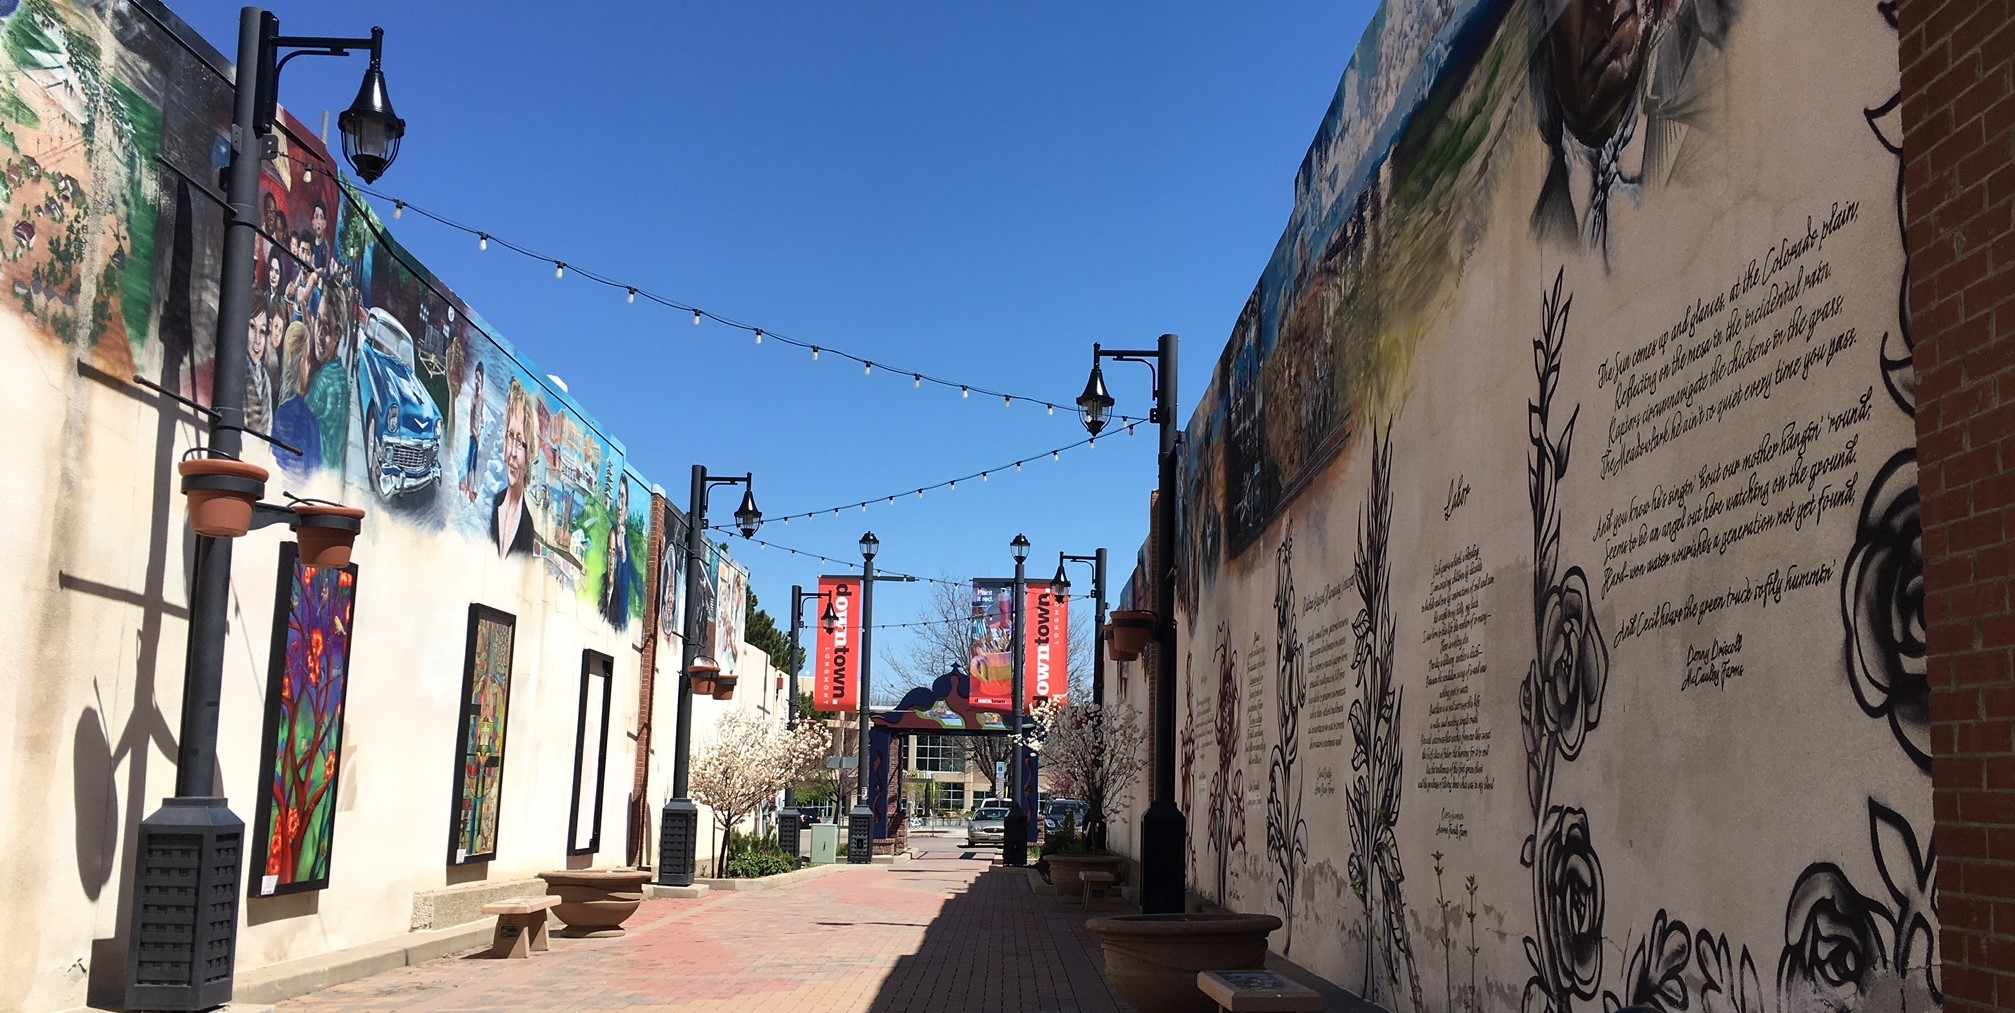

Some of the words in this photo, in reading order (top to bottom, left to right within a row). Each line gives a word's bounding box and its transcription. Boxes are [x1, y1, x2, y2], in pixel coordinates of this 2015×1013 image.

[1615, 371, 1657, 411] Reflecting
[1659, 363, 1670, 382] on
[1671, 344, 1688, 376] the
[1686, 337, 1712, 366] mesa
[1712, 328, 1722, 348] in
[1725, 307, 1742, 342] the
[1744, 264, 1804, 330] incidental
[1632, 342, 1658, 367] comes
[1658, 331, 1669, 355] up
[1671, 305, 1691, 341] and
[1729, 275, 1741, 302] at
[1742, 259, 1760, 294] the
[1762, 215, 1819, 286] Colorado
[1642, 372, 1709, 425] circumnavigate
[1709, 353, 1726, 387] the
[1726, 335, 1771, 377] chickens
[1772, 328, 1787, 350] in
[1787, 304, 1808, 342] the
[1669, 410, 1683, 441] he
[1704, 404, 1717, 422] so
[1717, 383, 1744, 424] quiet
[1744, 372, 1772, 400] every
[1775, 358, 1801, 385] time
[1801, 343, 1826, 381] you
[1592, 508, 1614, 542] And
[1612, 511, 1630, 537] you
[1629, 496, 1651, 521] know
[1722, 458, 1741, 481] our
[1741, 432, 1780, 470] mother
[1603, 538, 1630, 566] Seems
[1629, 533, 1639, 552] to
[1638, 523, 1648, 547] be
[1649, 526, 1661, 543] an
[1661, 504, 1687, 542] angel
[1686, 503, 1703, 527] out
[1702, 491, 1725, 522] here
[1725, 471, 1770, 512] watching
[1771, 474, 1788, 495] on
[1788, 455, 1808, 488] the
[1670, 527, 1711, 562] nourishes
[1719, 510, 1775, 555] generation
[1774, 500, 1796, 526] not
[1794, 493, 1816, 532] yet
[1636, 603, 1660, 637] Cecil
[1682, 593, 1699, 622] the
[1697, 596, 1726, 626] green
[1726, 577, 1752, 608] truck
[1752, 568, 1783, 609] softly
